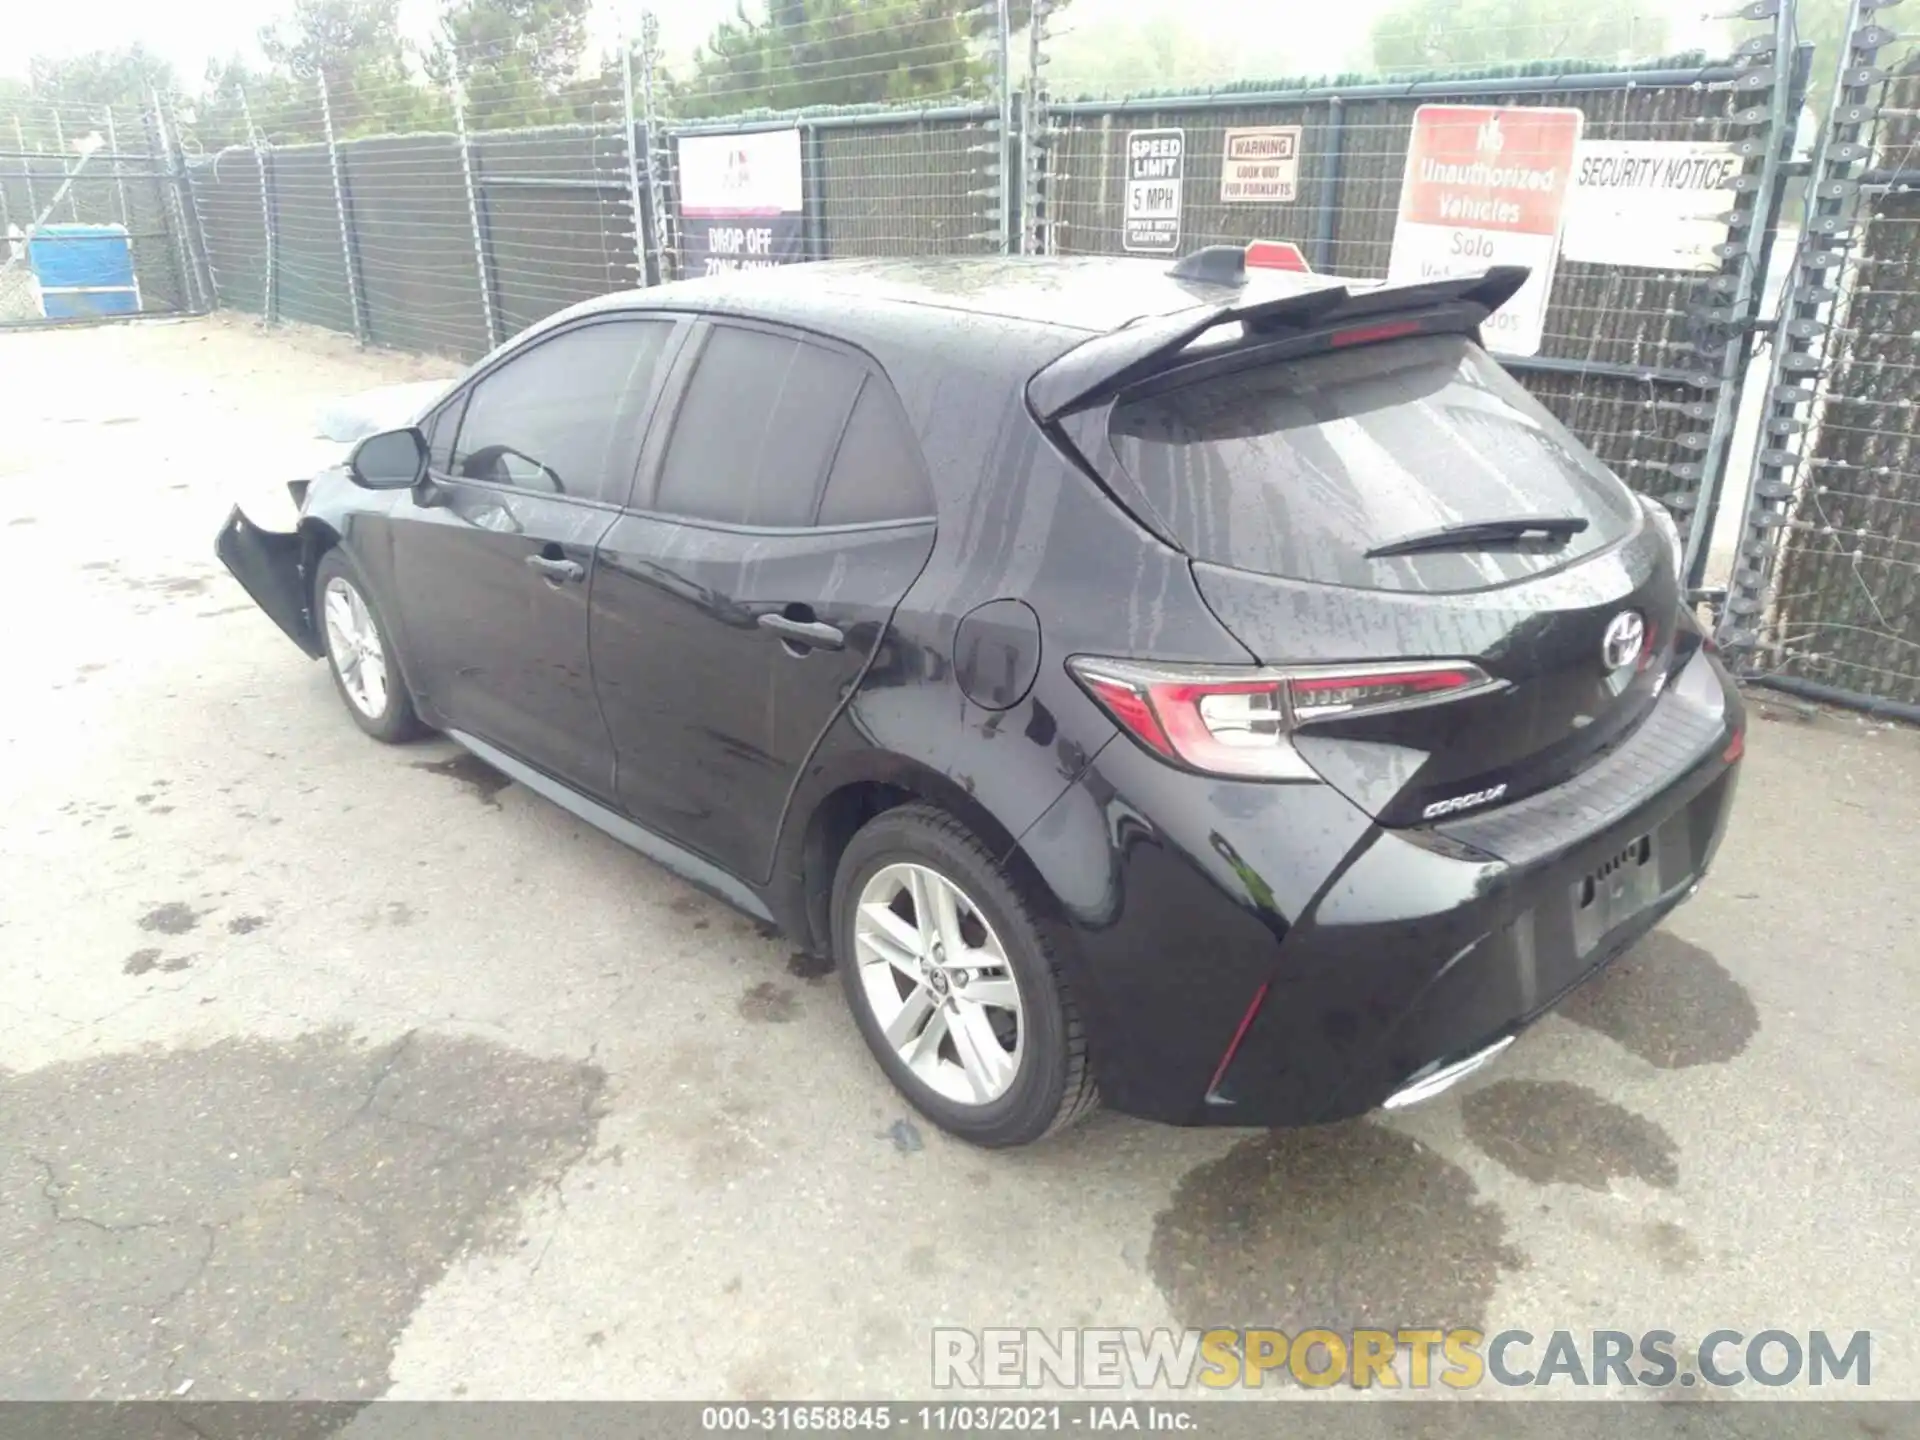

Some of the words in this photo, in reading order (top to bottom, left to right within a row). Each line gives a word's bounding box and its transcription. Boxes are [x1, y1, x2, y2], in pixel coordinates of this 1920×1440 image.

[1131, 139, 1181, 158] SPEED
[1236, 140, 1287, 155] WARNING
[1477, 122, 1505, 151] No
[1134, 158, 1176, 178] LIMIT
[1237, 166, 1259, 179] LOOK
[1261, 166, 1281, 179] OUT
[1421, 158, 1556, 192] Unauthorized
[1578, 156, 1665, 188] SECURITY
[1661, 158, 1734, 191] NOTICE
[1133, 188, 1142, 211] 5
[1146, 187, 1174, 211] MPH
[1243, 183, 1292, 196] FORKLIFTS
[1439, 190, 1521, 223] Vehicles
[708, 227, 744, 252] DROP
[746, 227, 772, 254] OFF
[1450, 231, 1494, 259] Solo
